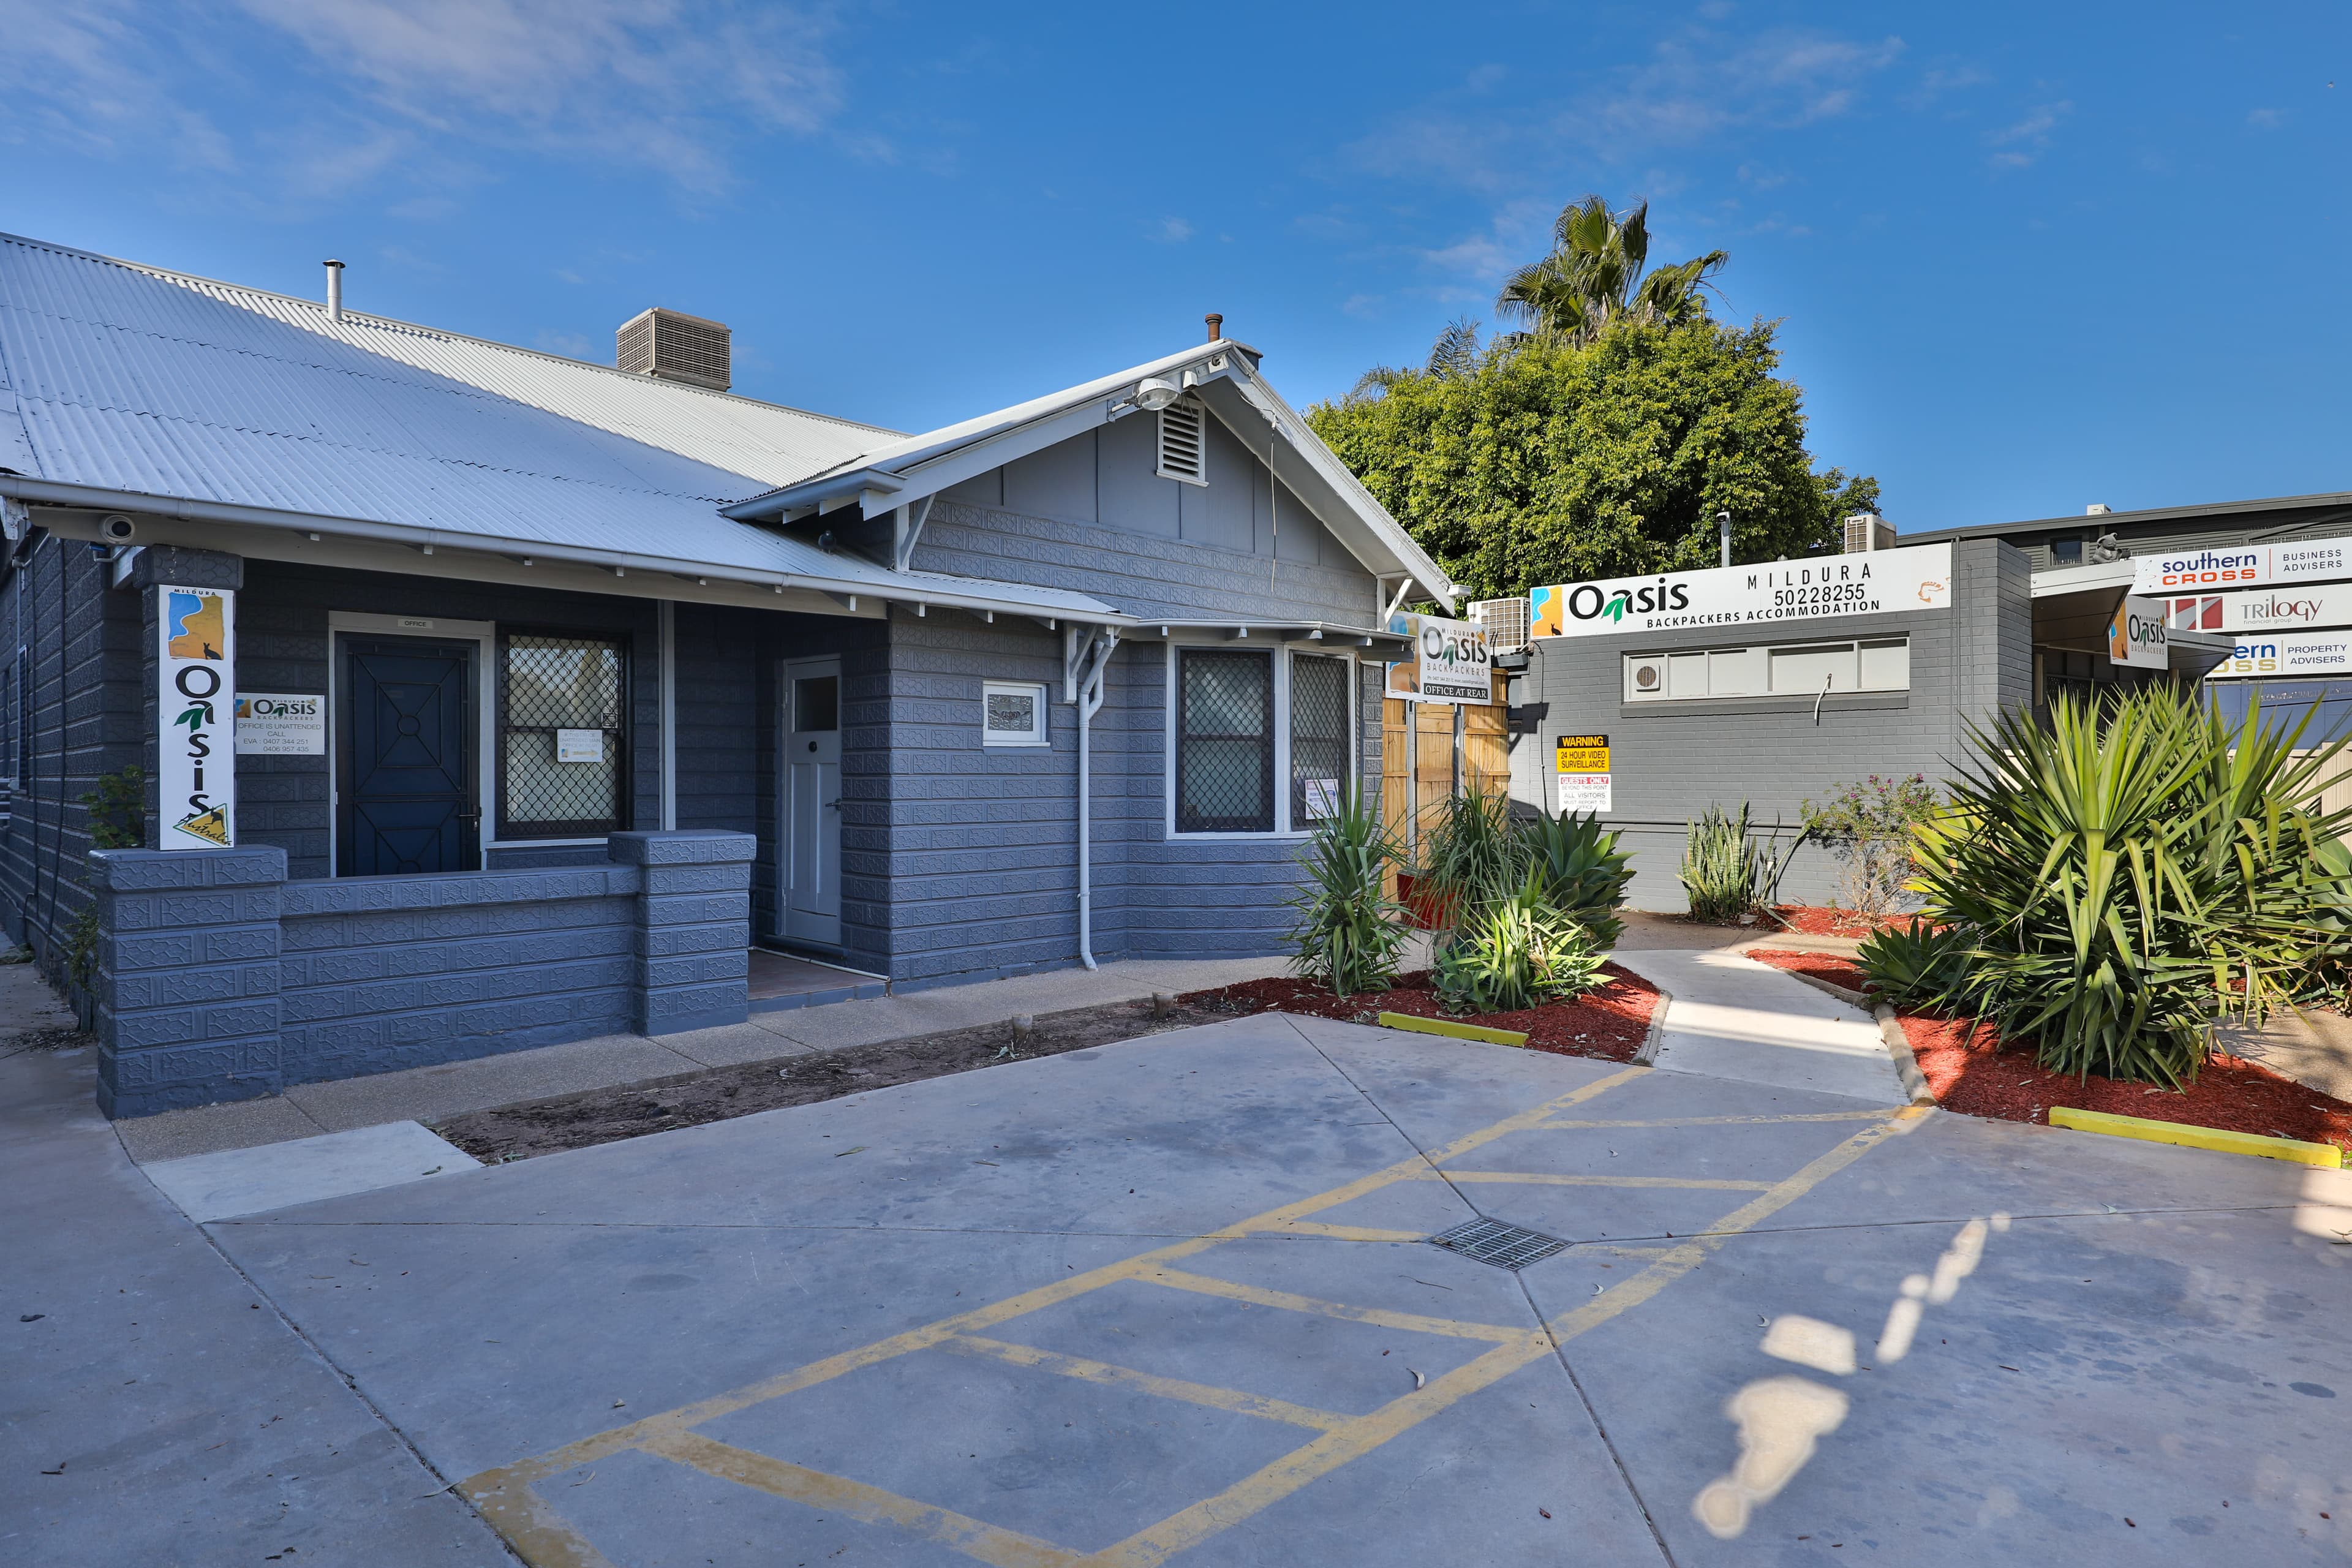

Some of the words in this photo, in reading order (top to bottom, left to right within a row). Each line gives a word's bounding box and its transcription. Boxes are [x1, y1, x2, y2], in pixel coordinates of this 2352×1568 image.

[2283, 549, 2342, 562] BUSINESS
[2162, 552, 2257, 573] southern
[2283, 560, 2343, 572] ADVISERS
[1747, 563, 1871, 590] MILDURA
[2162, 569, 2256, 586] CROSS
[1569, 577, 1689, 621] Oasis
[1774, 584, 1865, 606] 50228255
[1648, 612, 1740, 628] BACKPACKERS
[1747, 600, 1880, 621] ACCOMMODATION
[1441, 628, 1470, 637] MILDURA
[2128, 614, 2166, 644] Oasis
[1423, 626, 1487, 664] Oasis
[2131, 644, 2165, 655] BACKPACKERS
[2288, 644, 2347, 654] PROPERTY
[2290, 655, 2345, 665] ADVISERS
[1427, 663, 1485, 676] BACKPACKERS
[1425, 685, 1454, 696] OFFICE
[1455, 688, 1465, 696] AT
[1467, 689, 1487, 698] REAR
[254, 699, 317, 715] Oasis
[1562, 736, 1604, 747] WARNING
[1561, 760, 1605, 769] SURVEILLANCE
